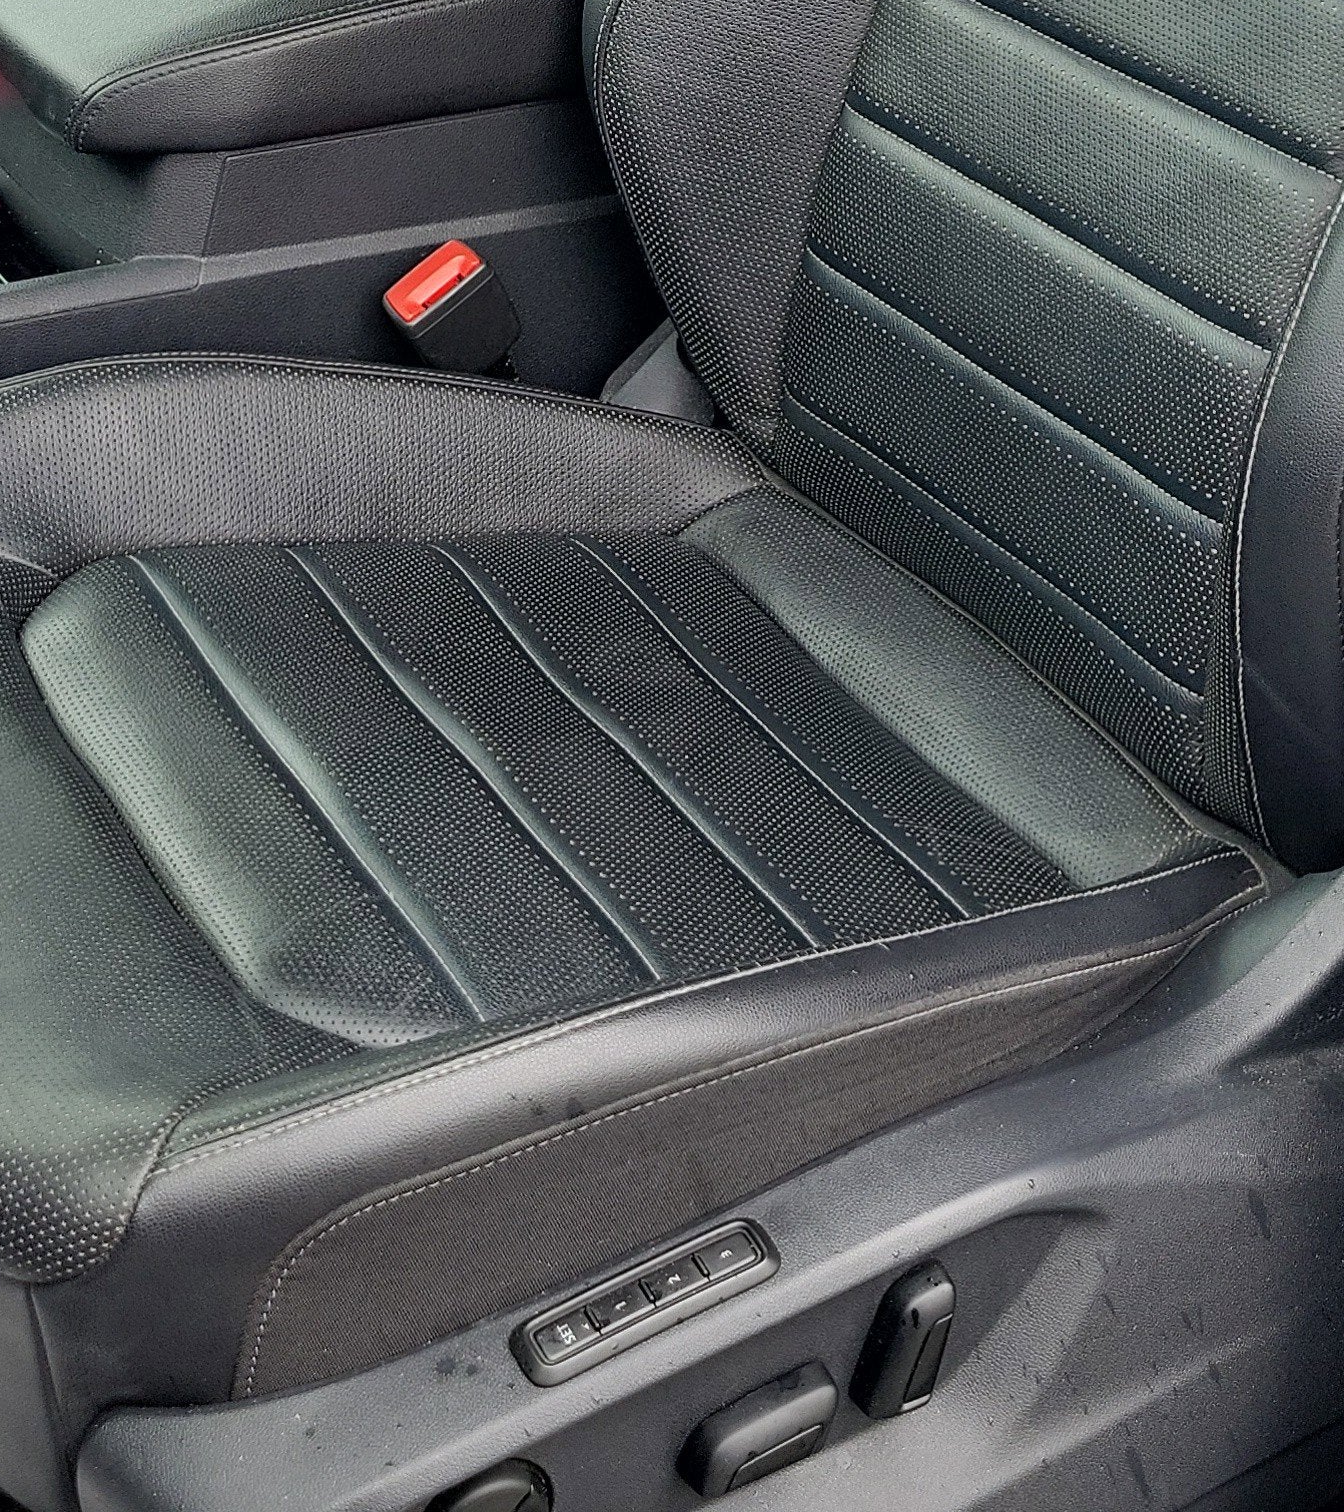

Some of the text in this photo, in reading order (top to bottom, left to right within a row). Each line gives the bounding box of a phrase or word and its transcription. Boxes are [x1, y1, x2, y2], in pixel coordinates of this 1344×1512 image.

[720, 1248, 733, 1259] 3
[667, 1273, 682, 1285] 2
[615, 1300, 627, 1311] 1
[556, 1322, 577, 1346] SET
